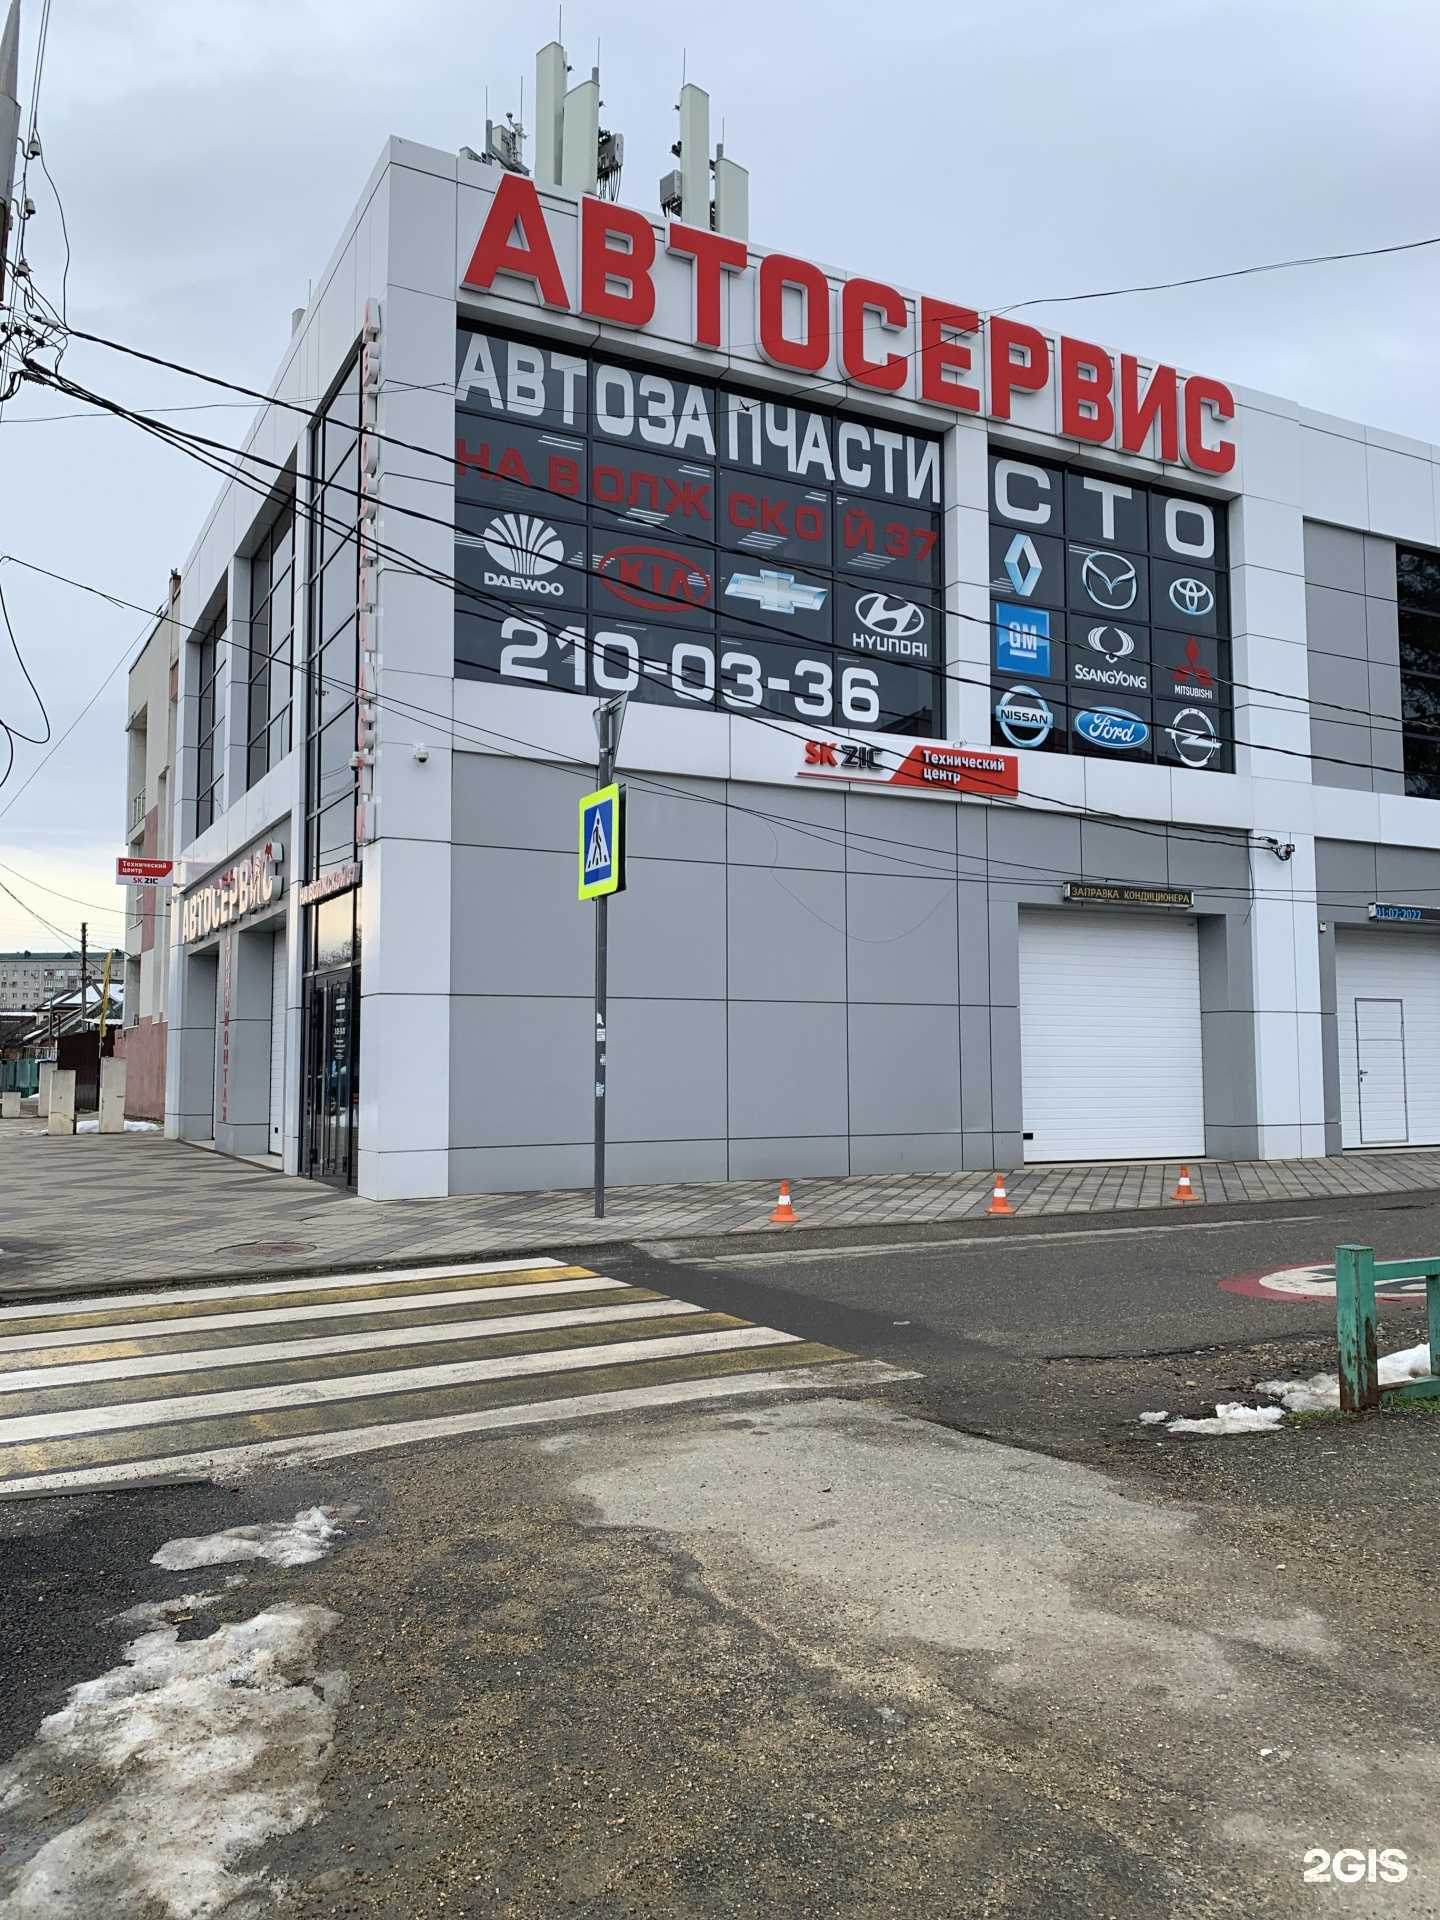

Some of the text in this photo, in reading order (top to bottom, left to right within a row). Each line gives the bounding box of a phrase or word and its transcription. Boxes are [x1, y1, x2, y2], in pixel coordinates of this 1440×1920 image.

[461, 172, 1236, 476] АВТОСЕРВИС
[458, 334, 941, 504] АВТОЗАПЧАСТИ
[455, 437, 938, 561] НА ВОЛЖСКОЙ 37
[994, 459, 1216, 559] СТО
[484, 572, 565, 597] DAEWOO
[618, 559, 696, 600] KIA
[852, 632, 928, 658] HYUNDAI
[1009, 621, 1038, 651] GM
[499, 616, 880, 724] 210-03-36
[1174, 684, 1213, 700] MITSUBISHI
[1000, 708, 1049, 725] NISSAN
[1089, 713, 1136, 743] Ford
[804, 740, 884, 770] SK ZIC
[923, 750, 1005, 771] Технический
[923, 767, 961, 783] центр
[122, 860, 167, 869] Технический
[1071, 886, 1190, 904] ЗАПРАВКА КОНДИЦИОНЕРА
